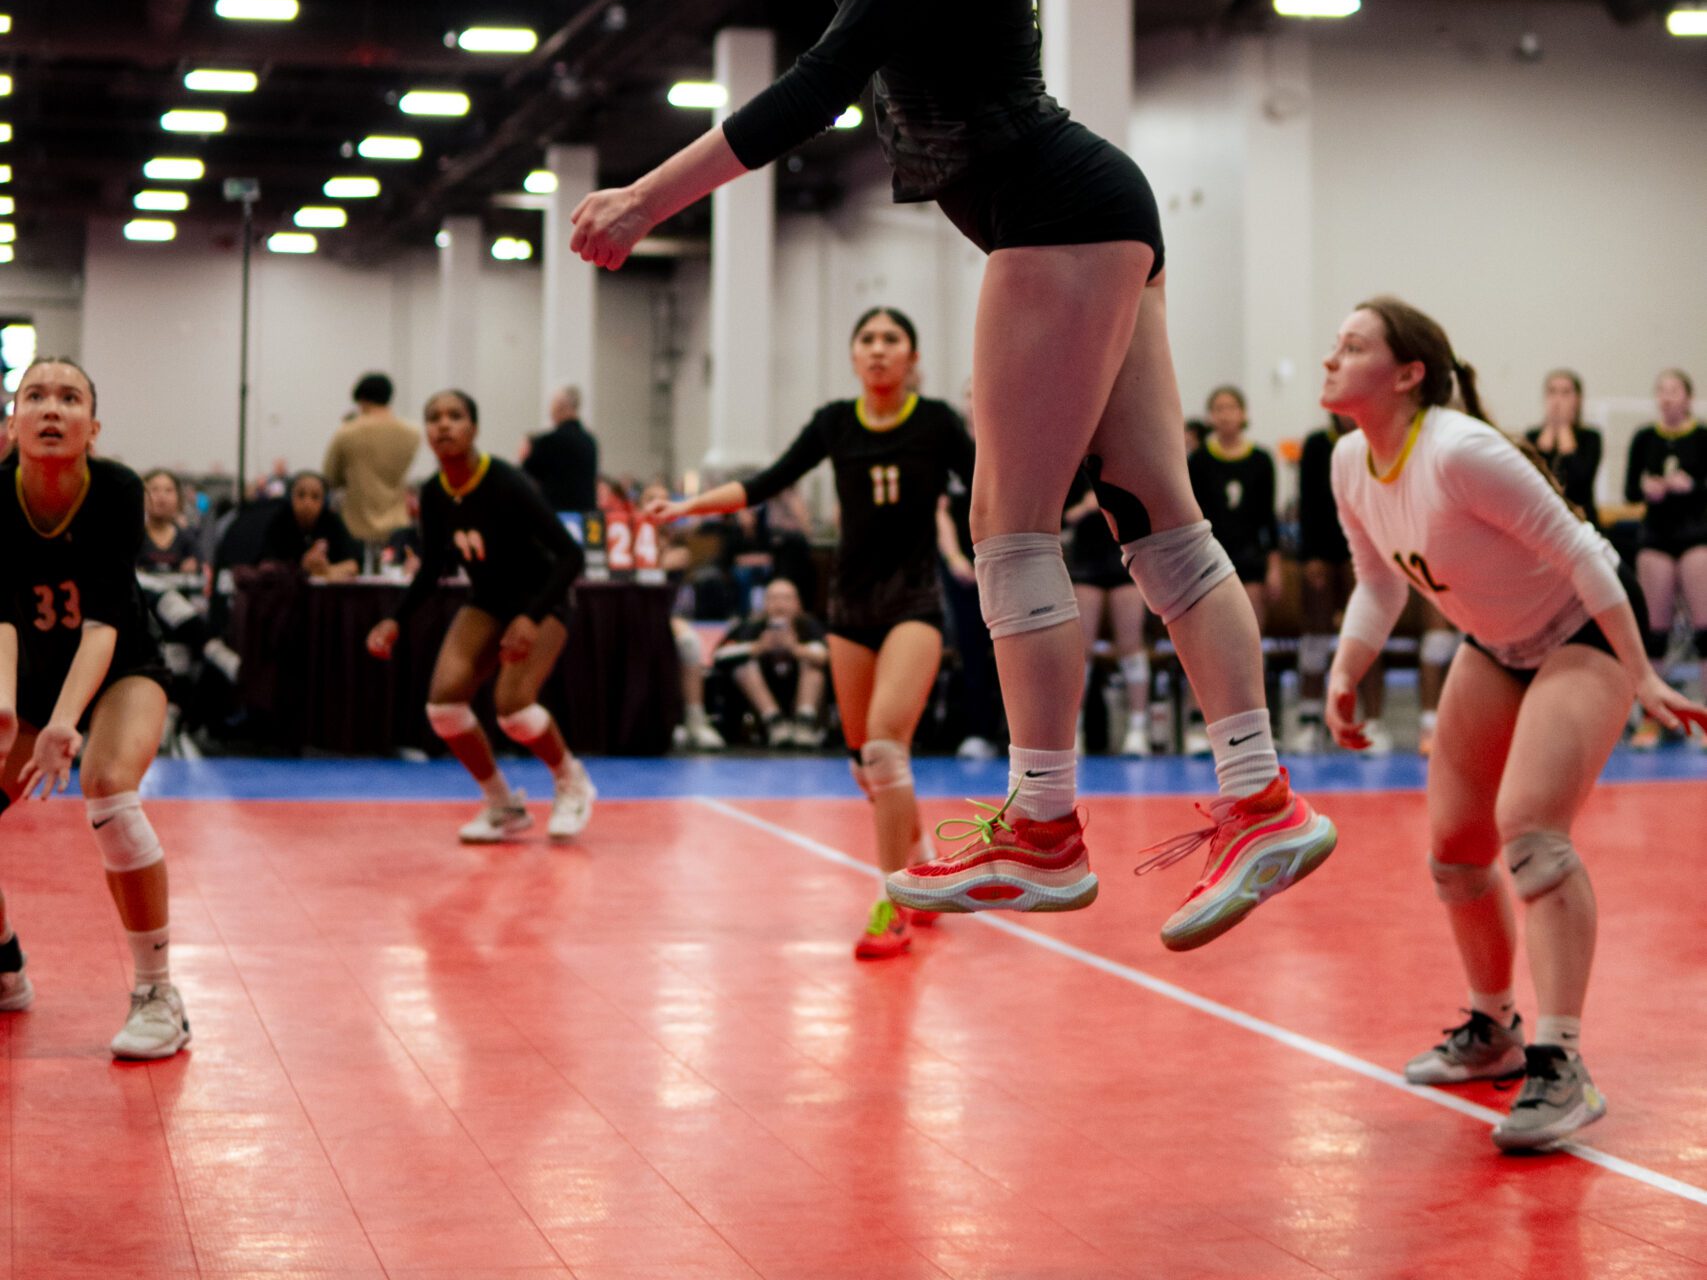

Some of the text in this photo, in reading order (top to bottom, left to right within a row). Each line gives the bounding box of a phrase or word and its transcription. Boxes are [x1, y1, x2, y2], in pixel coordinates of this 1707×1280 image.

[870, 465, 900, 506] 11
[607, 522, 657, 564] 24
[1393, 552, 1450, 592] 12
[33, 580, 81, 631] 33
